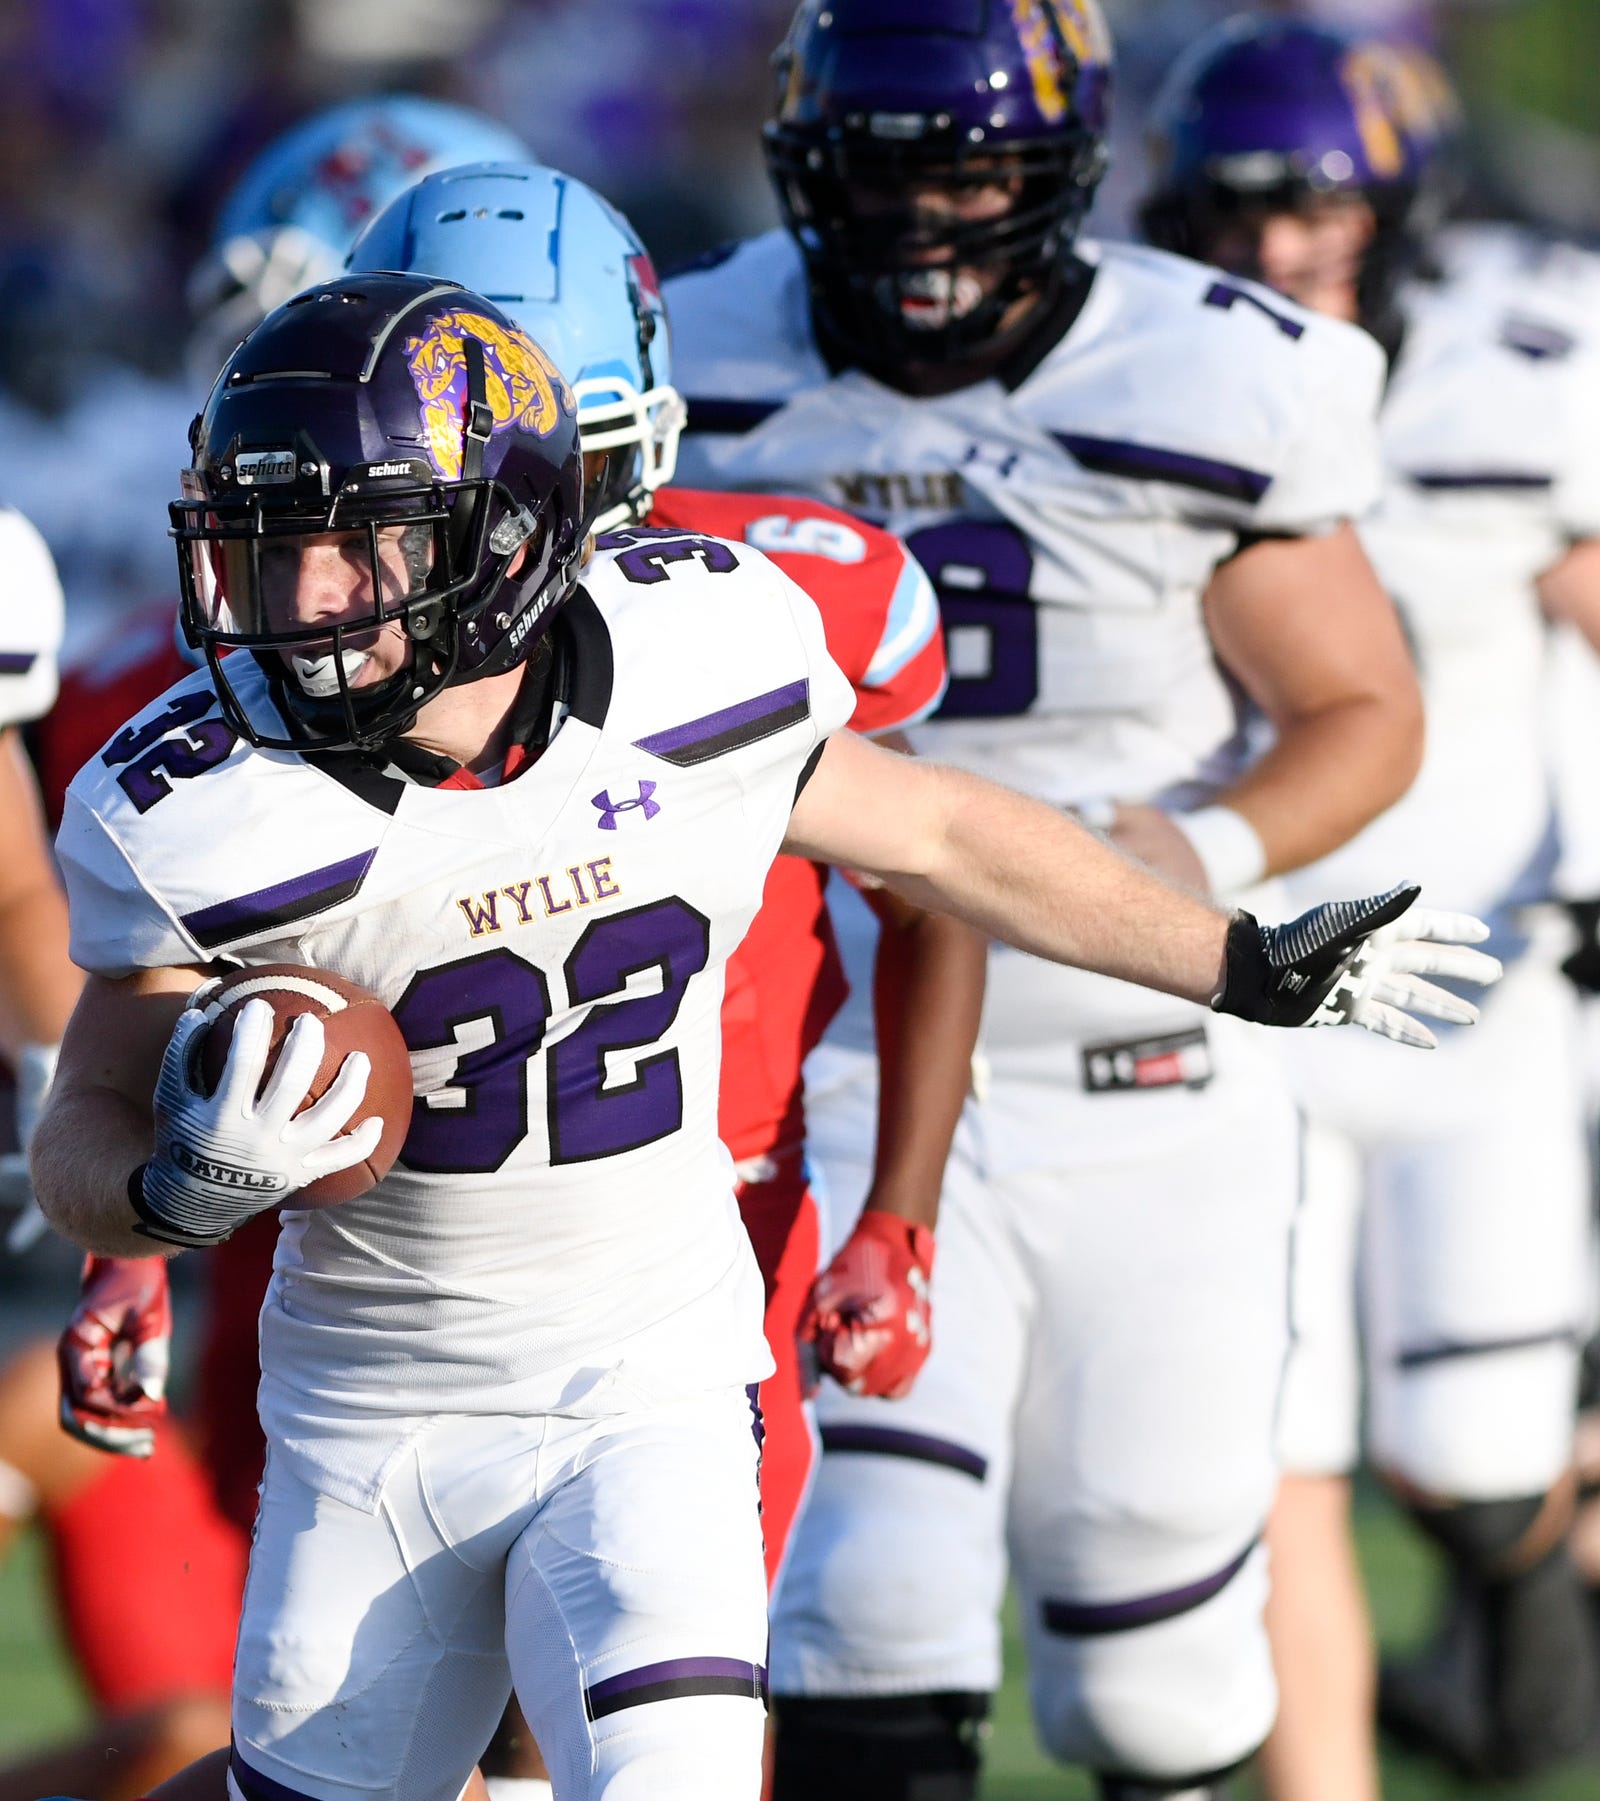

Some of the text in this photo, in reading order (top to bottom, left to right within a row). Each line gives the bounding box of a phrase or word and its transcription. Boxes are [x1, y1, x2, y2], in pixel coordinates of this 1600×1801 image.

[239, 460, 292, 478] schutt
[368, 462, 412, 478] schutt
[509, 589, 551, 649] schutt
[101, 689, 238, 815] 32
[456, 855, 622, 938] WYLIE
[390, 894, 711, 1174] 32
[180, 1149, 278, 1188] BATTLE
